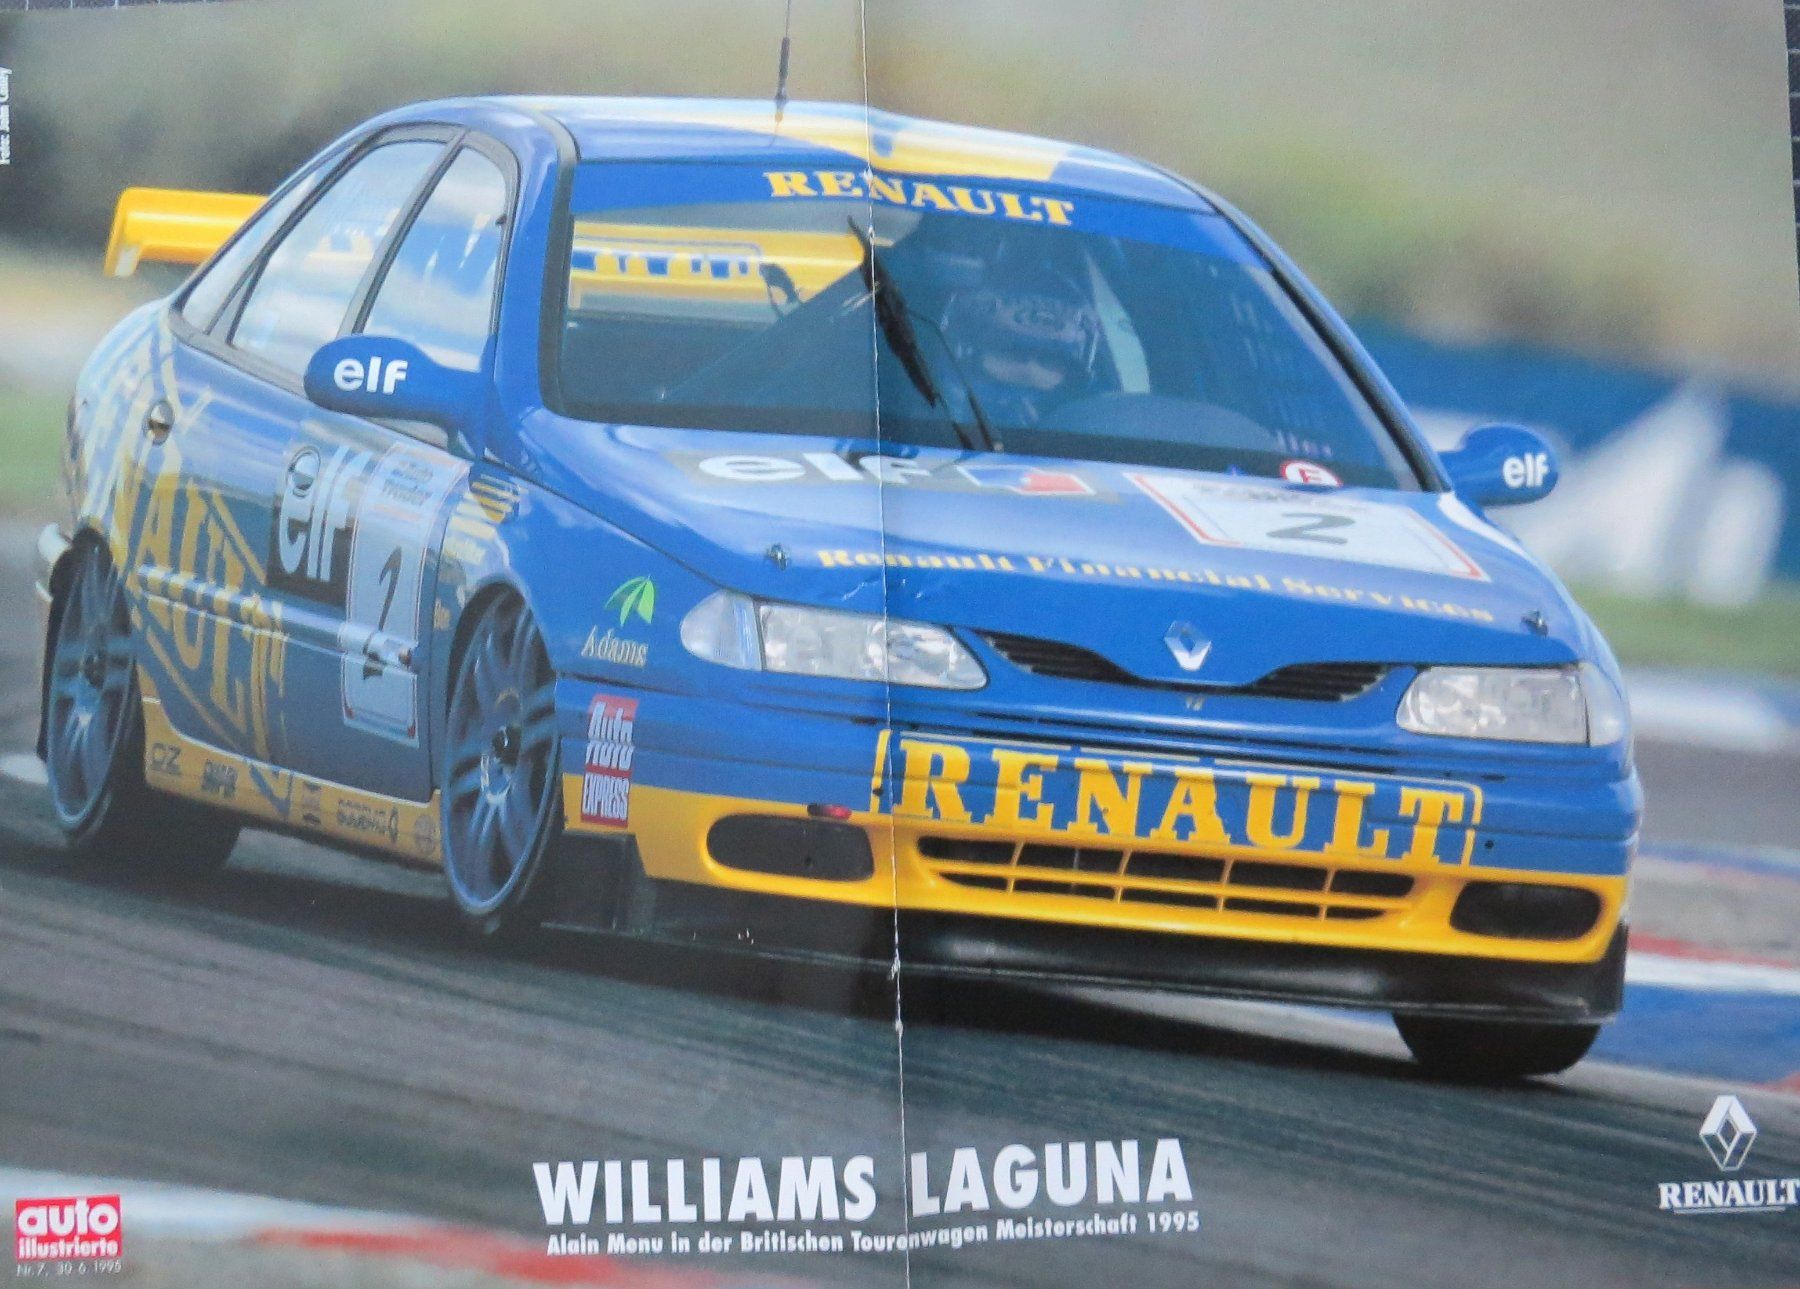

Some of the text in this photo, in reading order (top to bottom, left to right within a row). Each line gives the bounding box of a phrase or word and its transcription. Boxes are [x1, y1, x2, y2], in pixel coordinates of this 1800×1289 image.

[763, 170, 1075, 226] RENAULT
[333, 356, 408, 395] elf
[699, 453, 930, 484] elf
[1502, 452, 1549, 488] elf
[1267, 513, 1355, 545] 2
[816, 548, 1016, 572] Renault
[582, 624, 649, 667] Adams
[893, 739, 1464, 864] RENAULT
[532, 1138, 1193, 1226] WILLIAMS LAGUNA
[1658, 1179, 1800, 1209] RENAULT
[18, 1199, 119, 1237] auto
[547, 1210, 1200, 1256] Alain Menu in der Britischen Tourenwagen Meisterschaft 1995
[19, 1236, 119, 1259] illustrierte
